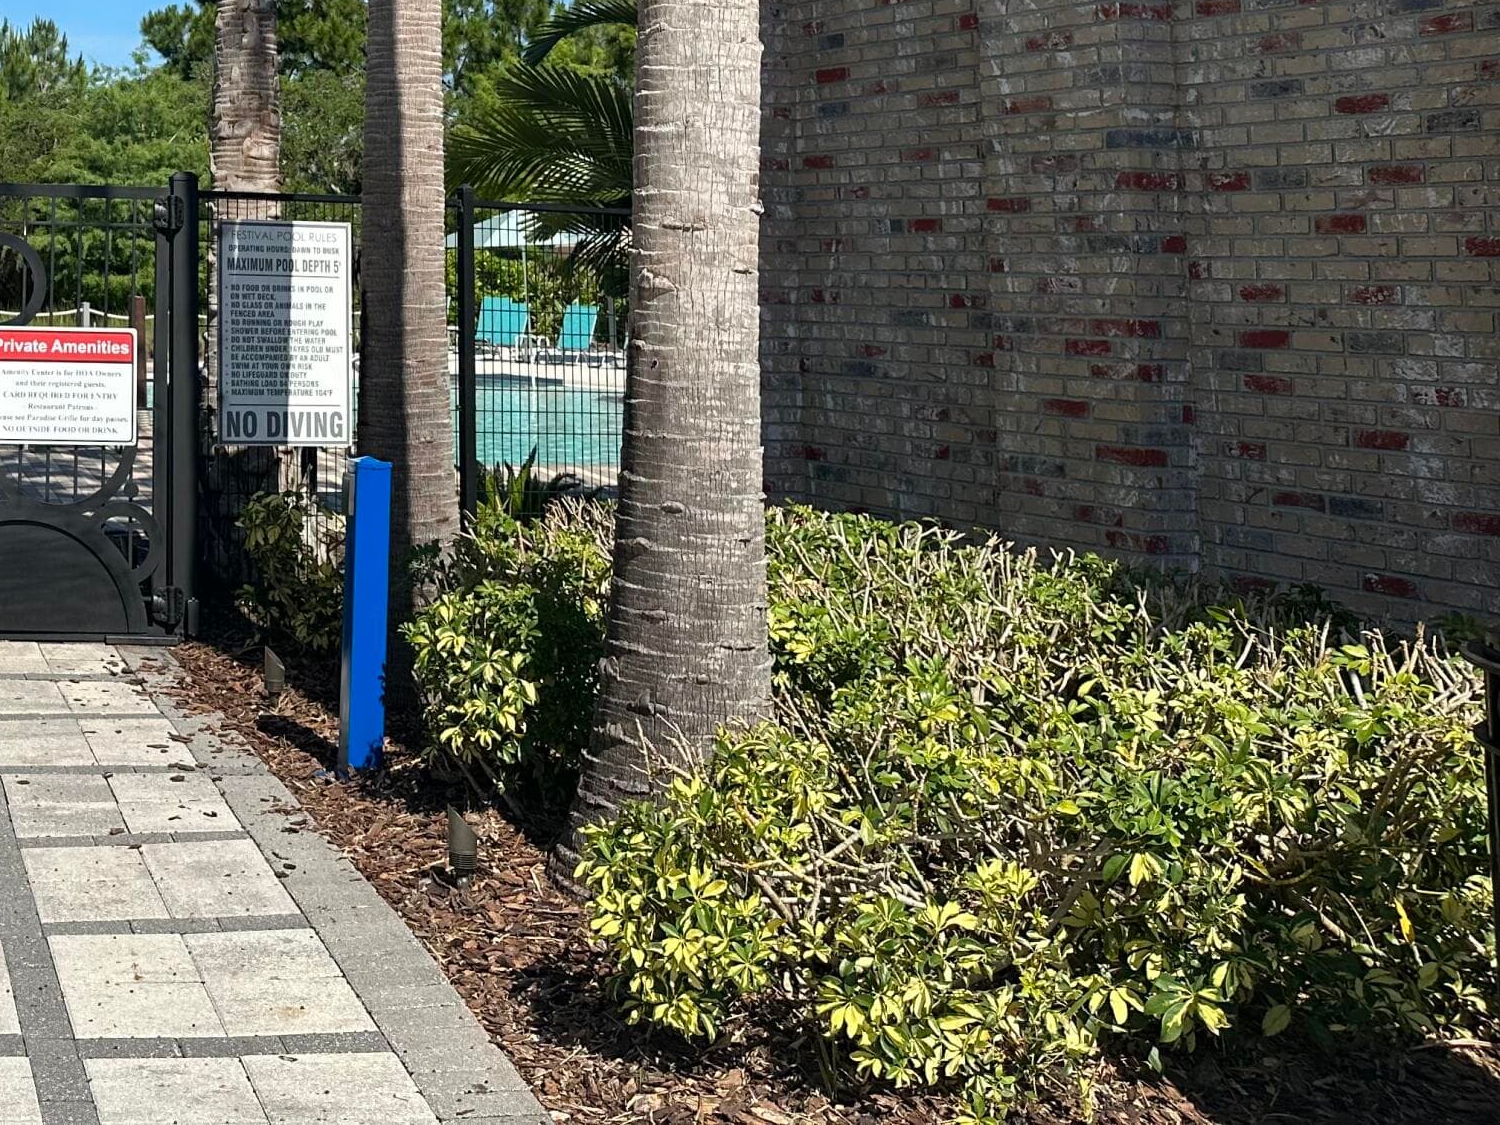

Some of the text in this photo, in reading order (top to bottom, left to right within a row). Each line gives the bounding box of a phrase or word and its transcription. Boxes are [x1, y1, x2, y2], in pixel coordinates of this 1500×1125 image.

[231, 230, 337, 242] FESTIVAL POOL RULES
[227, 258, 273, 271] MAXIMUM
[276, 258, 300, 272] POOL
[303, 260, 330, 272] DEPTH
[52, 340, 130, 354] Amenities
[226, 411, 343, 438] NO DIVING
